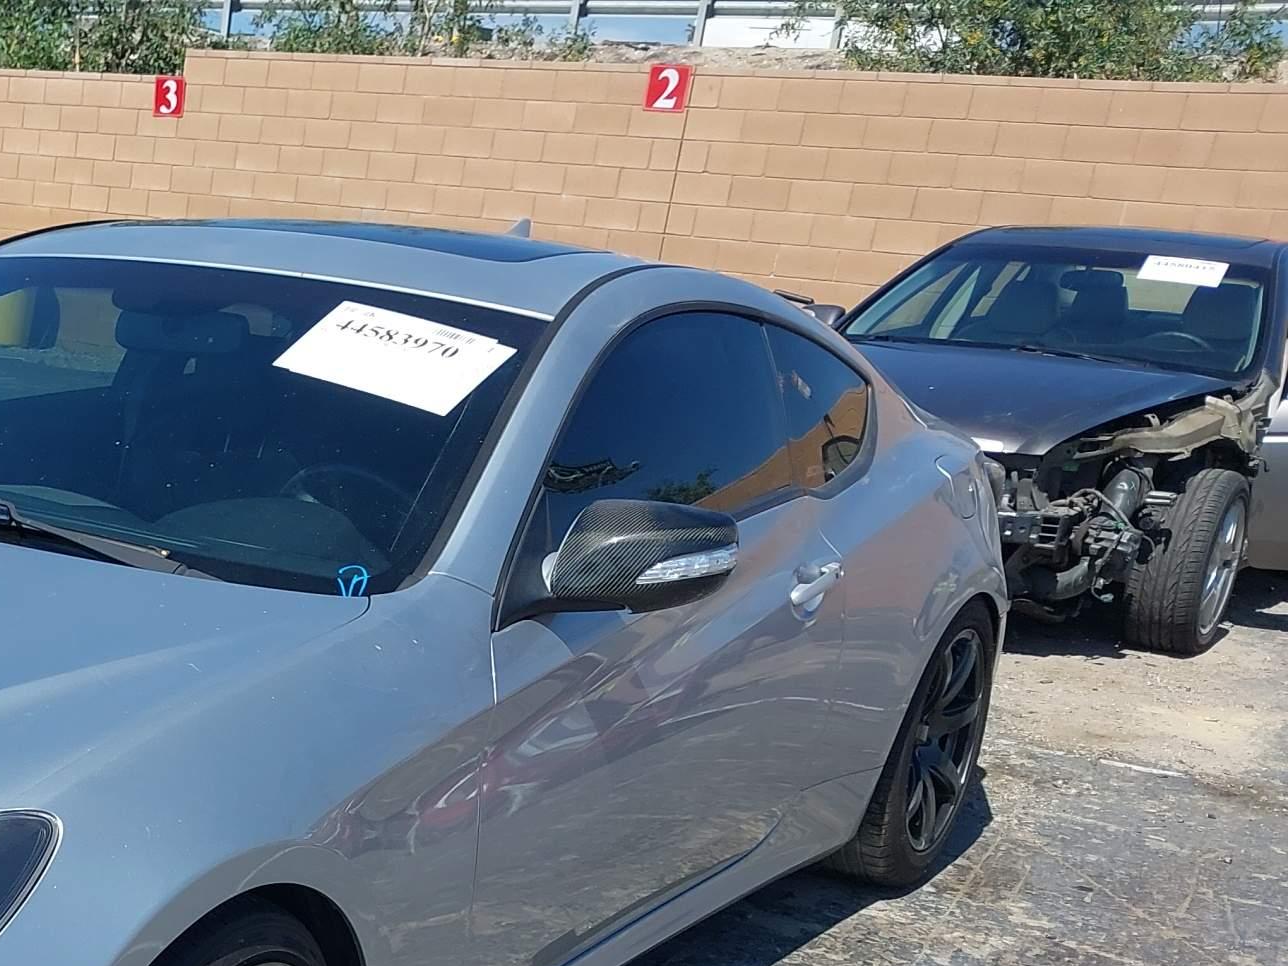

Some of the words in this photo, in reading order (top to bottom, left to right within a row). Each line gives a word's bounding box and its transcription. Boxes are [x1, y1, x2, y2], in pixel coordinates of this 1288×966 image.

[159, 79, 178, 113] 3
[652, 68, 679, 109] 2
[336, 319, 460, 358] 44583970
